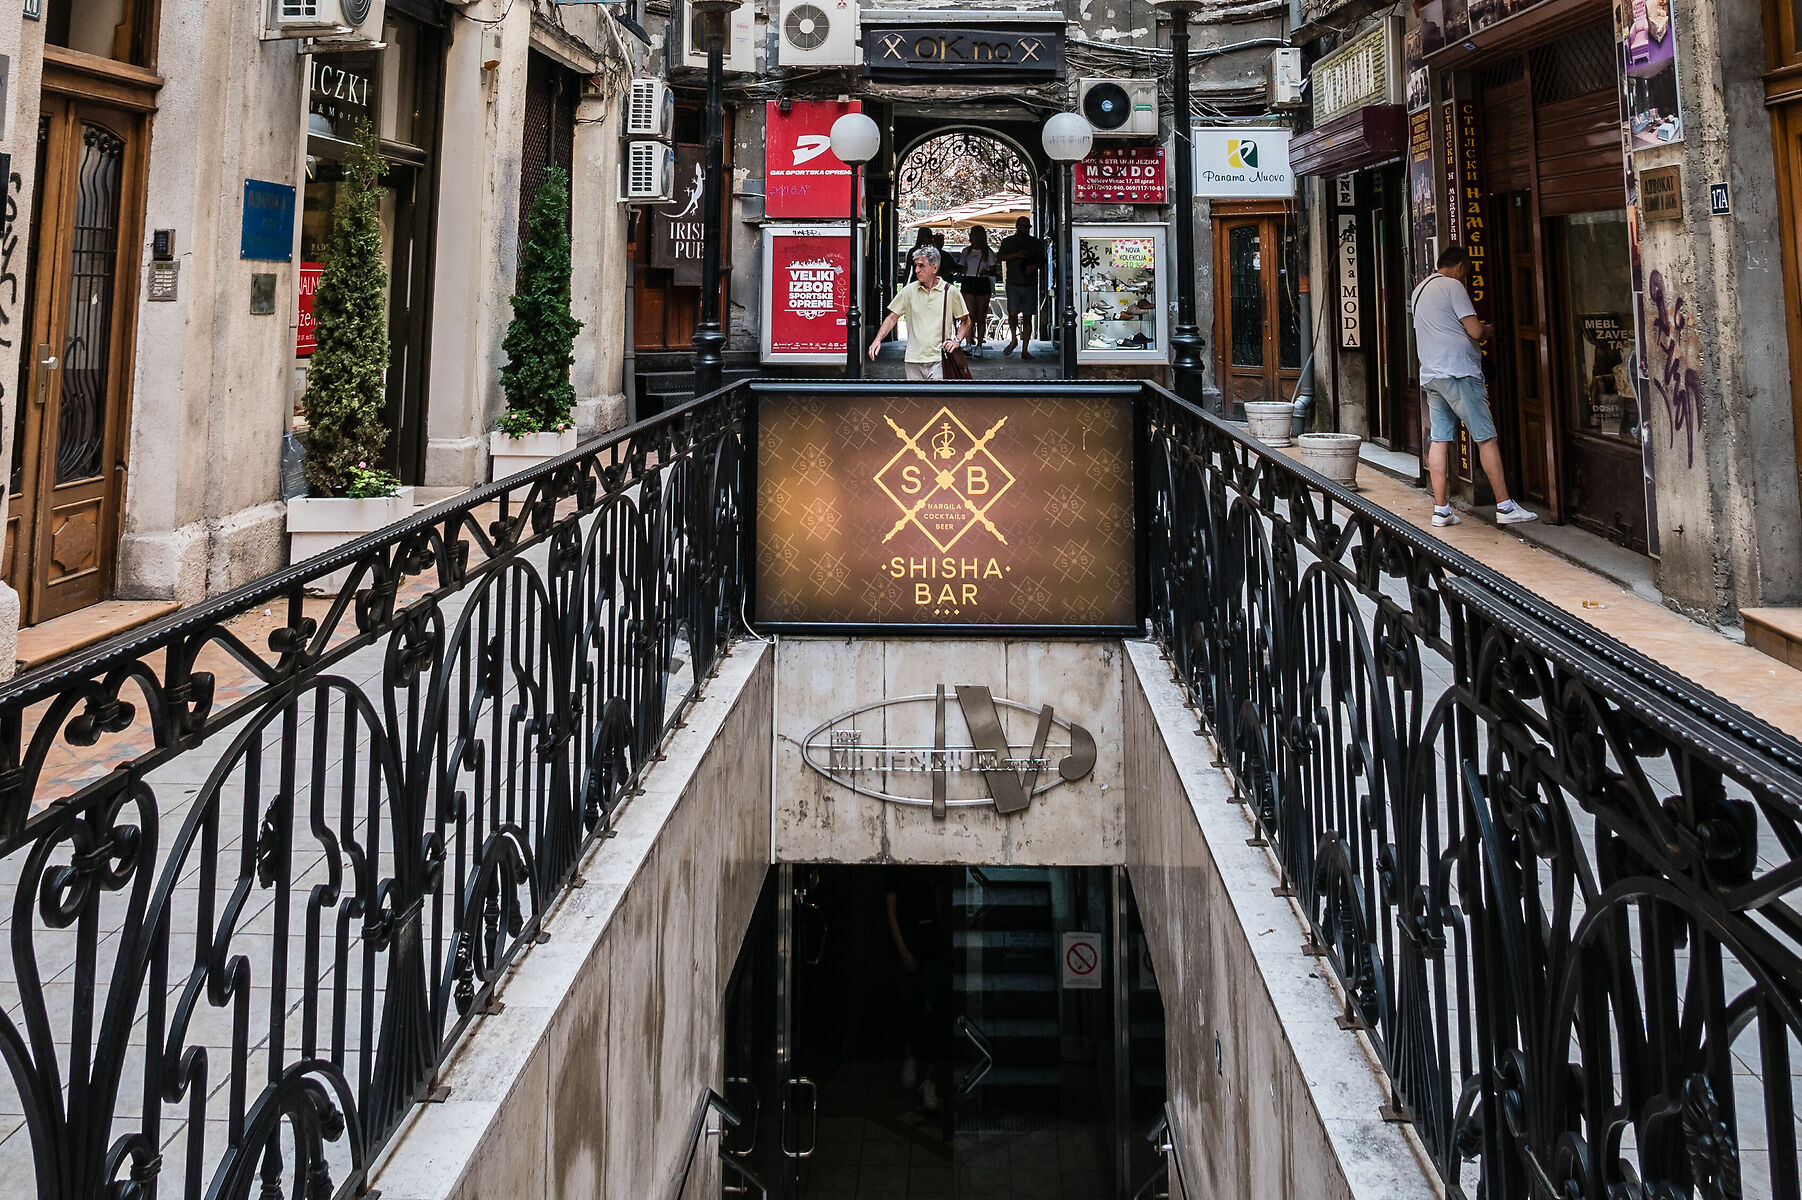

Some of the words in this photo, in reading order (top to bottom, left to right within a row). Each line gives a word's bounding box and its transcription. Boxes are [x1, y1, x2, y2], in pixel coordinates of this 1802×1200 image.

[1463, 104, 1478, 181] СТИЛСКИ
[1202, 170, 1245, 182] Panama
[1248, 171, 1285, 183] Nuovo
[1711, 188, 1729, 210] 17A
[1466, 187, 1485, 302] НАМЕШТАЈ
[788, 281, 834, 292] IZBOR
[789, 270, 835, 281] VELIKI
[788, 292, 834, 300] SPORTSKE
[788, 299, 834, 308] OPREME
[1342, 285, 1358, 346] MODA
[1584, 319, 1619, 329] MEBL
[901, 465, 922, 495] S
[966, 466, 990, 496] B
[889, 556, 1003, 579] SHISHA
[914, 582, 978, 605] BAR
